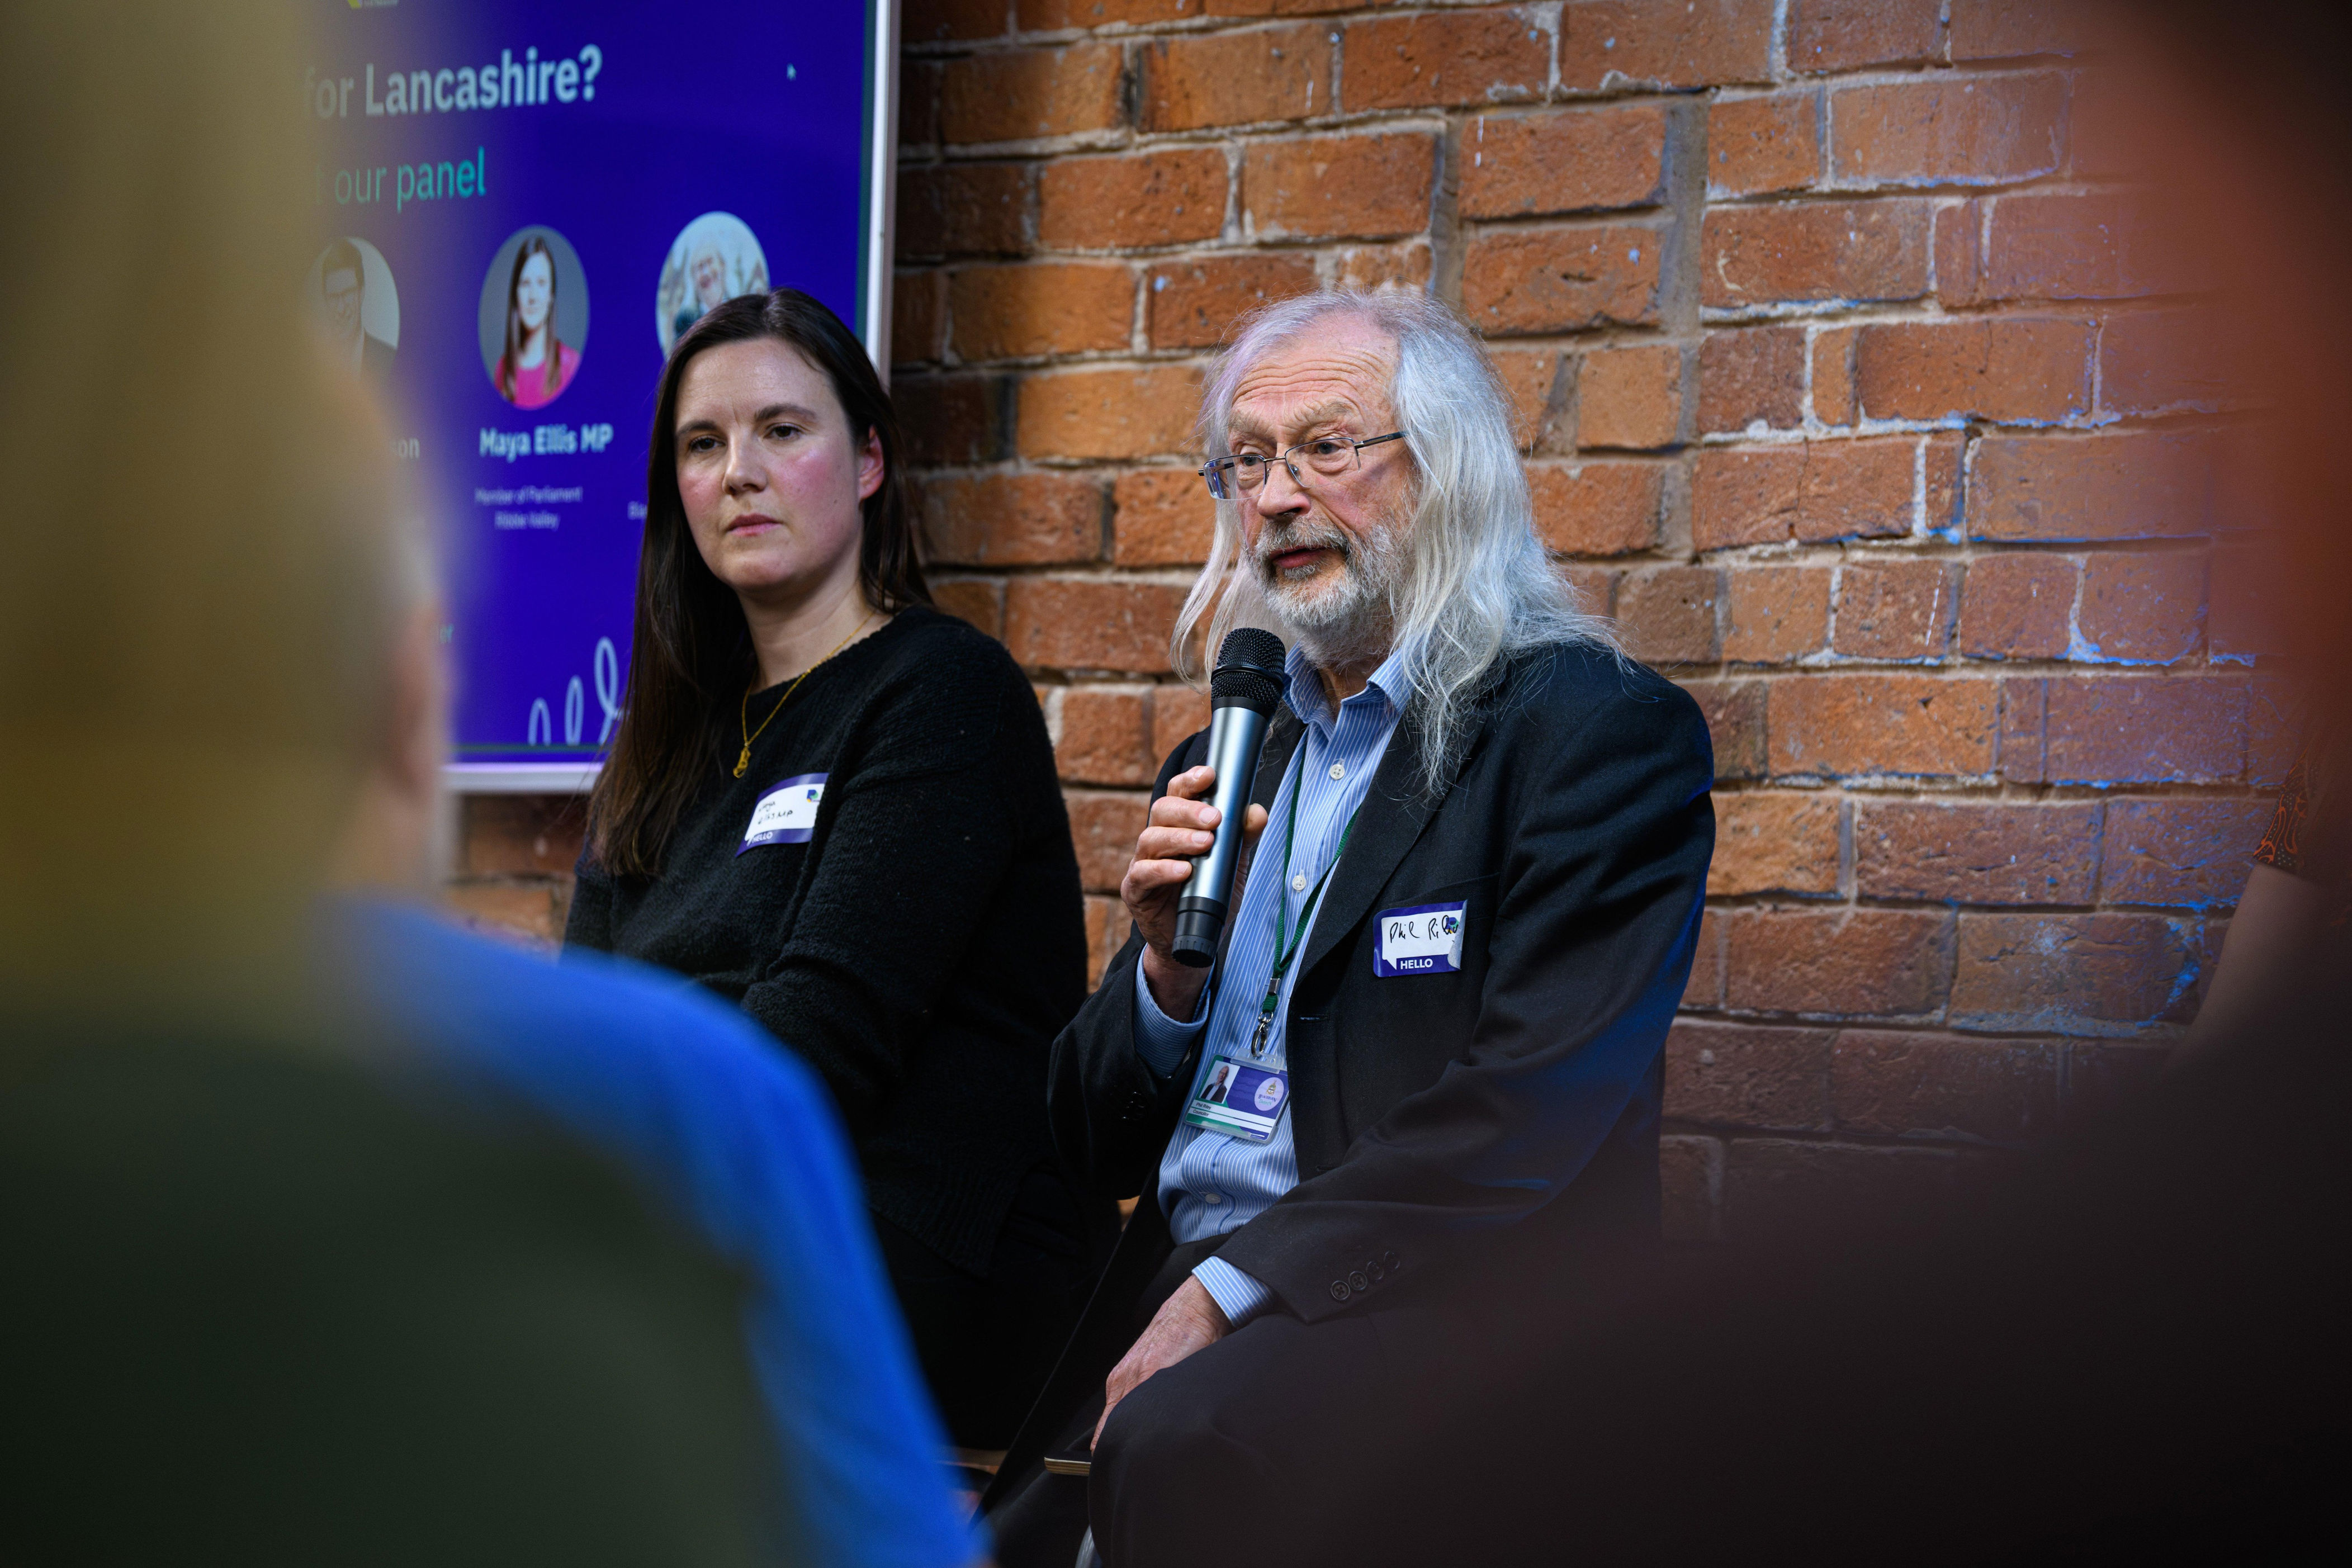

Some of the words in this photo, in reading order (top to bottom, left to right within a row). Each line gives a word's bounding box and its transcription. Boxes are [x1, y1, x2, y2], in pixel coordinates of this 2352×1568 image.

[365, 44, 603, 115] Lancashire?
[335, 165, 387, 205] our
[396, 145, 486, 212] panel
[479, 428, 532, 462] Maya
[533, 423, 578, 454] Ellis
[580, 423, 614, 453] MP
[1390, 921, 1420, 943] Phil
[1400, 958, 1433, 970] HELLO
